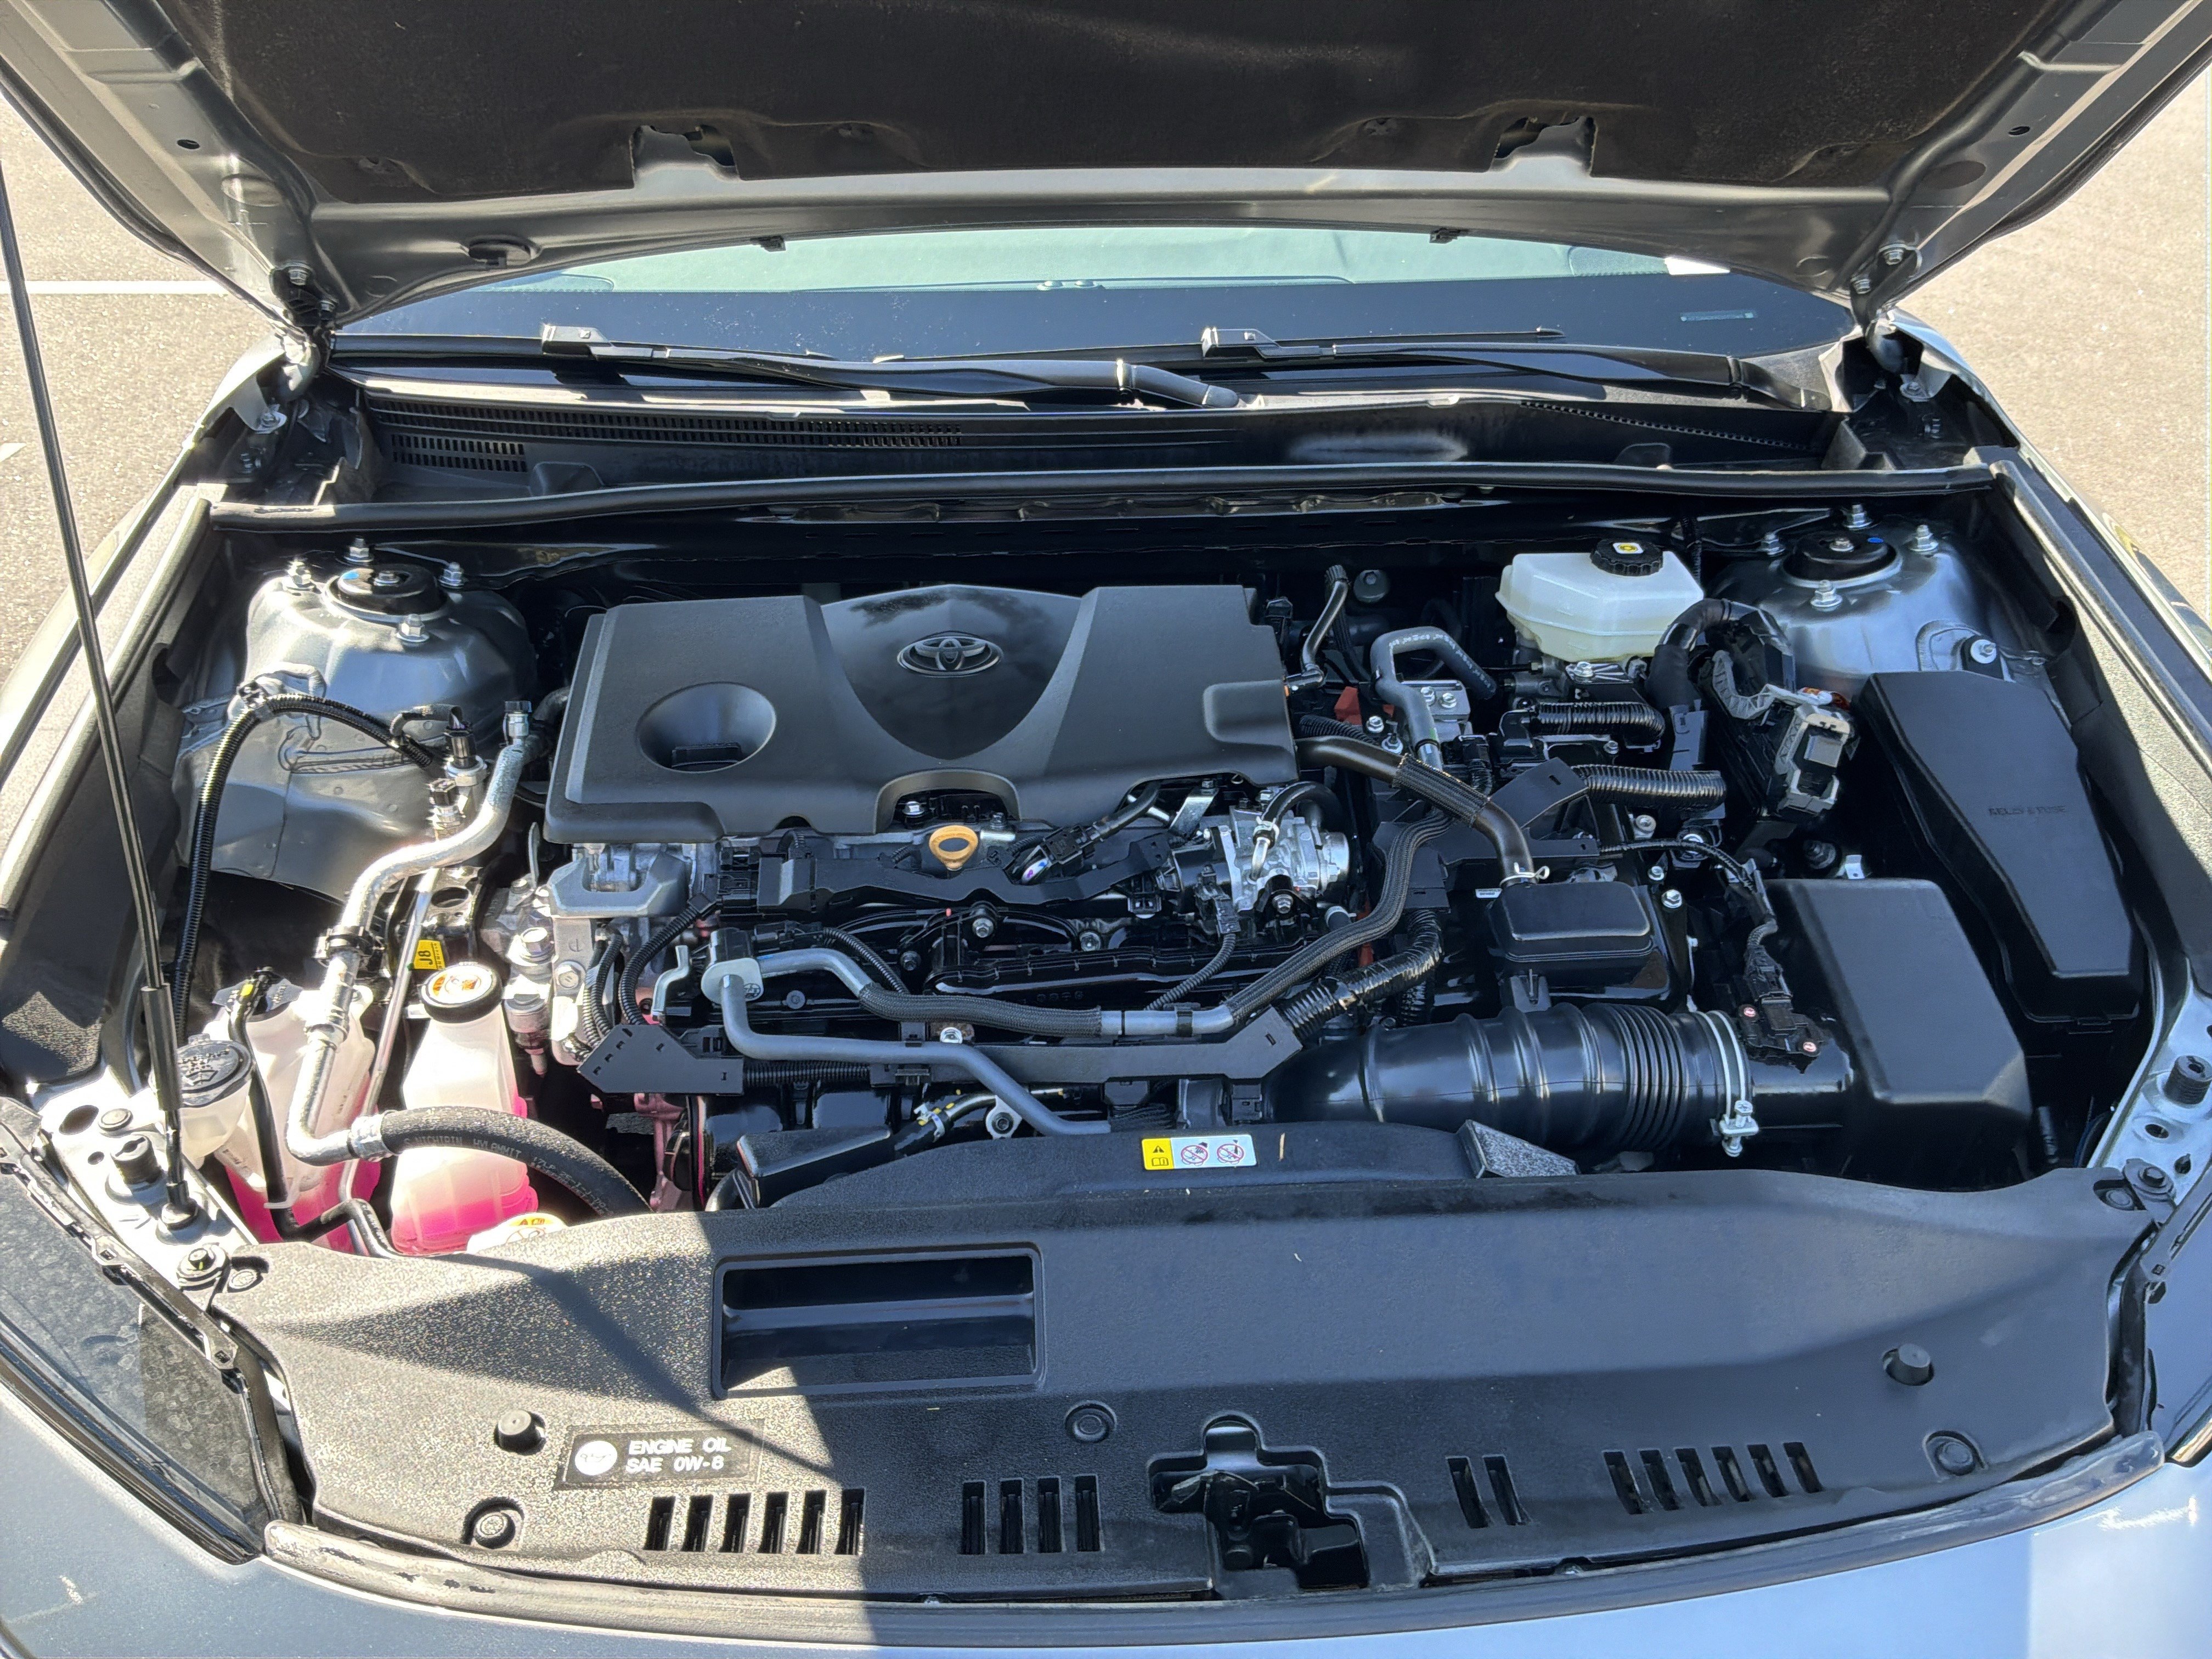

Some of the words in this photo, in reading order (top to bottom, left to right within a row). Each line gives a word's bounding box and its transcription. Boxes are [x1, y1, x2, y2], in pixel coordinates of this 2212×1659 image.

[417, 950, 433, 965] J8
[628, 1438, 694, 1455] ENGINE
[702, 1437, 732, 1453] OIL
[625, 1457, 663, 1473] SAE
[674, 1455, 725, 1472] 0W-8
